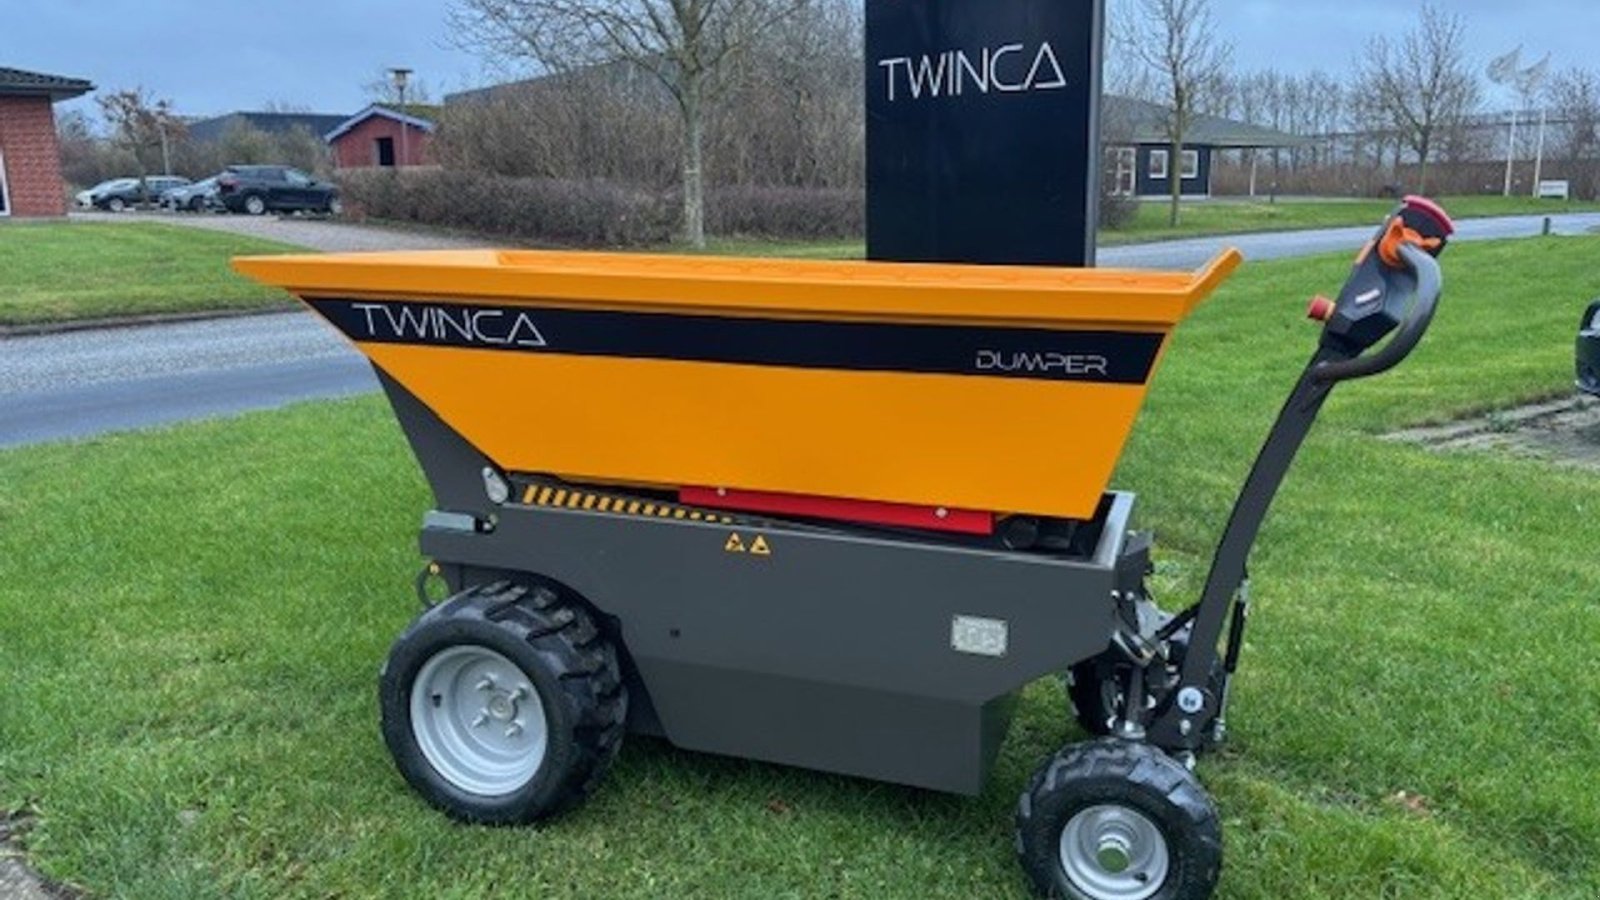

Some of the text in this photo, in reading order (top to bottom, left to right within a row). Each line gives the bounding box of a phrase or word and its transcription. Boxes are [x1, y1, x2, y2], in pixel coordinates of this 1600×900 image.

[878, 41, 1067, 101] TWINCA
[351, 302, 547, 346] TWINCA
[975, 349, 1109, 376] DUMPER
